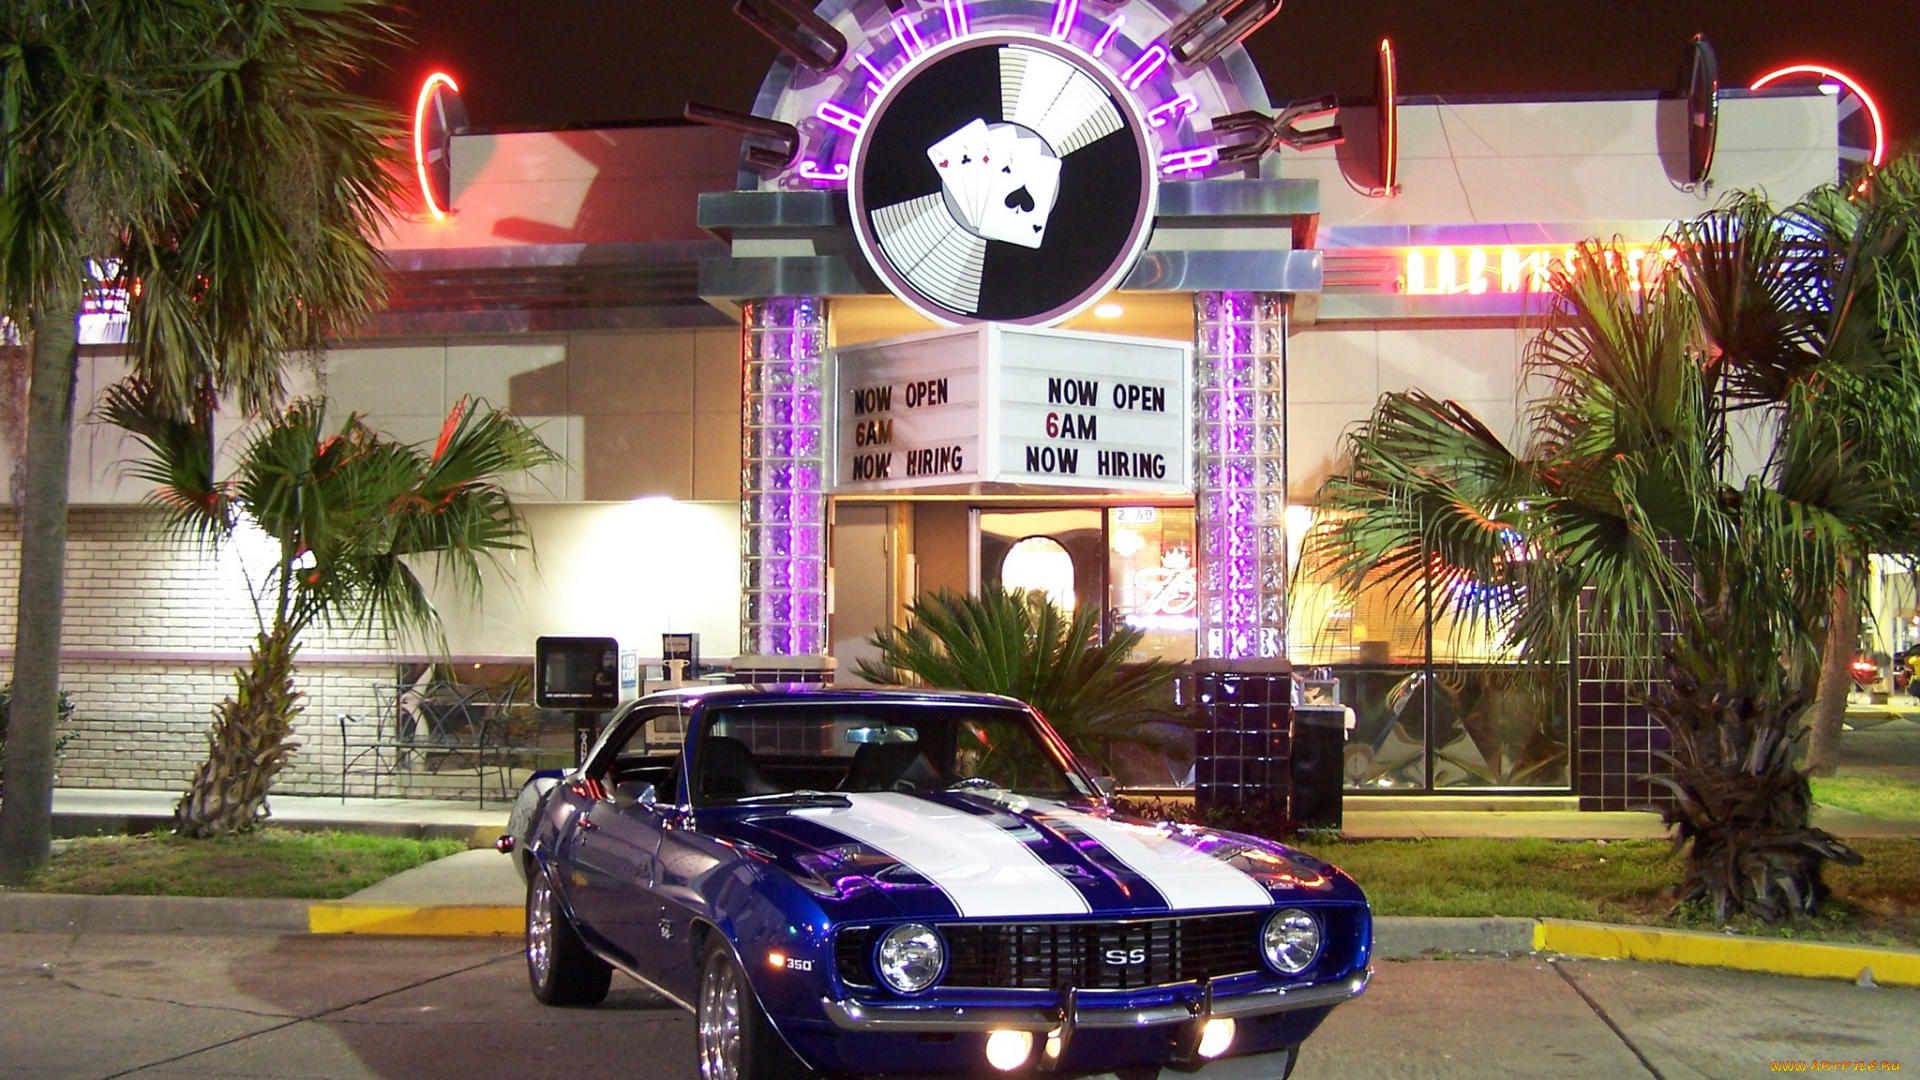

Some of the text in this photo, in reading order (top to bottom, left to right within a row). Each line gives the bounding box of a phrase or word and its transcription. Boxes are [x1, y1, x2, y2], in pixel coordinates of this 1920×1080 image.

[854, 378, 948, 415] NOW OPEN
[1048, 377, 1165, 412] NOW OPEN
[855, 419, 893, 447] 6AM
[1046, 413, 1097, 441] 6AM
[852, 446, 963, 480] NOW HIRING
[1026, 446, 1165, 479] NOW HIRING
[786, 958, 813, 971] 350
[1105, 949, 1145, 964] SS
